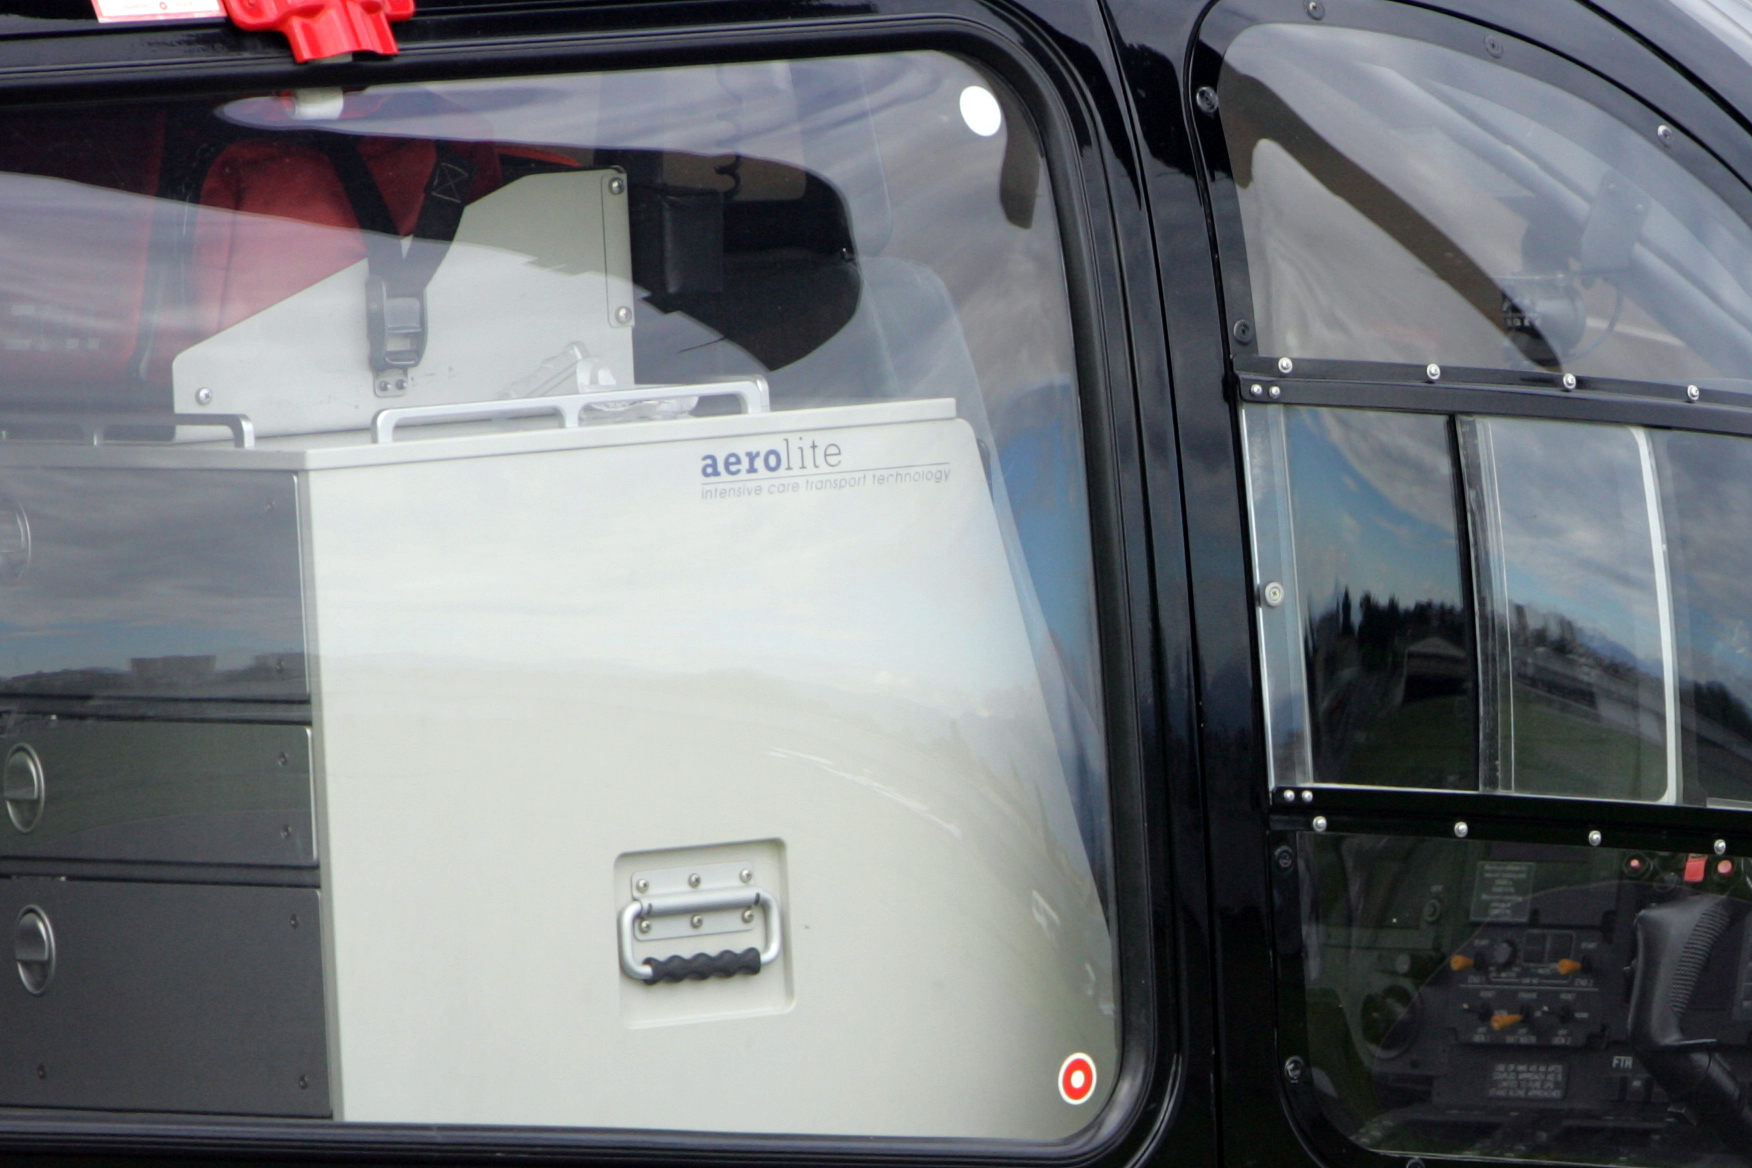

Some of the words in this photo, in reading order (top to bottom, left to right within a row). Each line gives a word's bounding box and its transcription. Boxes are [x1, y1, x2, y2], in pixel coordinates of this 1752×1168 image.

[701, 437, 842, 477] aerolite
[701, 483, 763, 500] intensive
[767, 480, 800, 495] care
[804, 474, 867, 492] transport
[872, 467, 951, 486] technology
